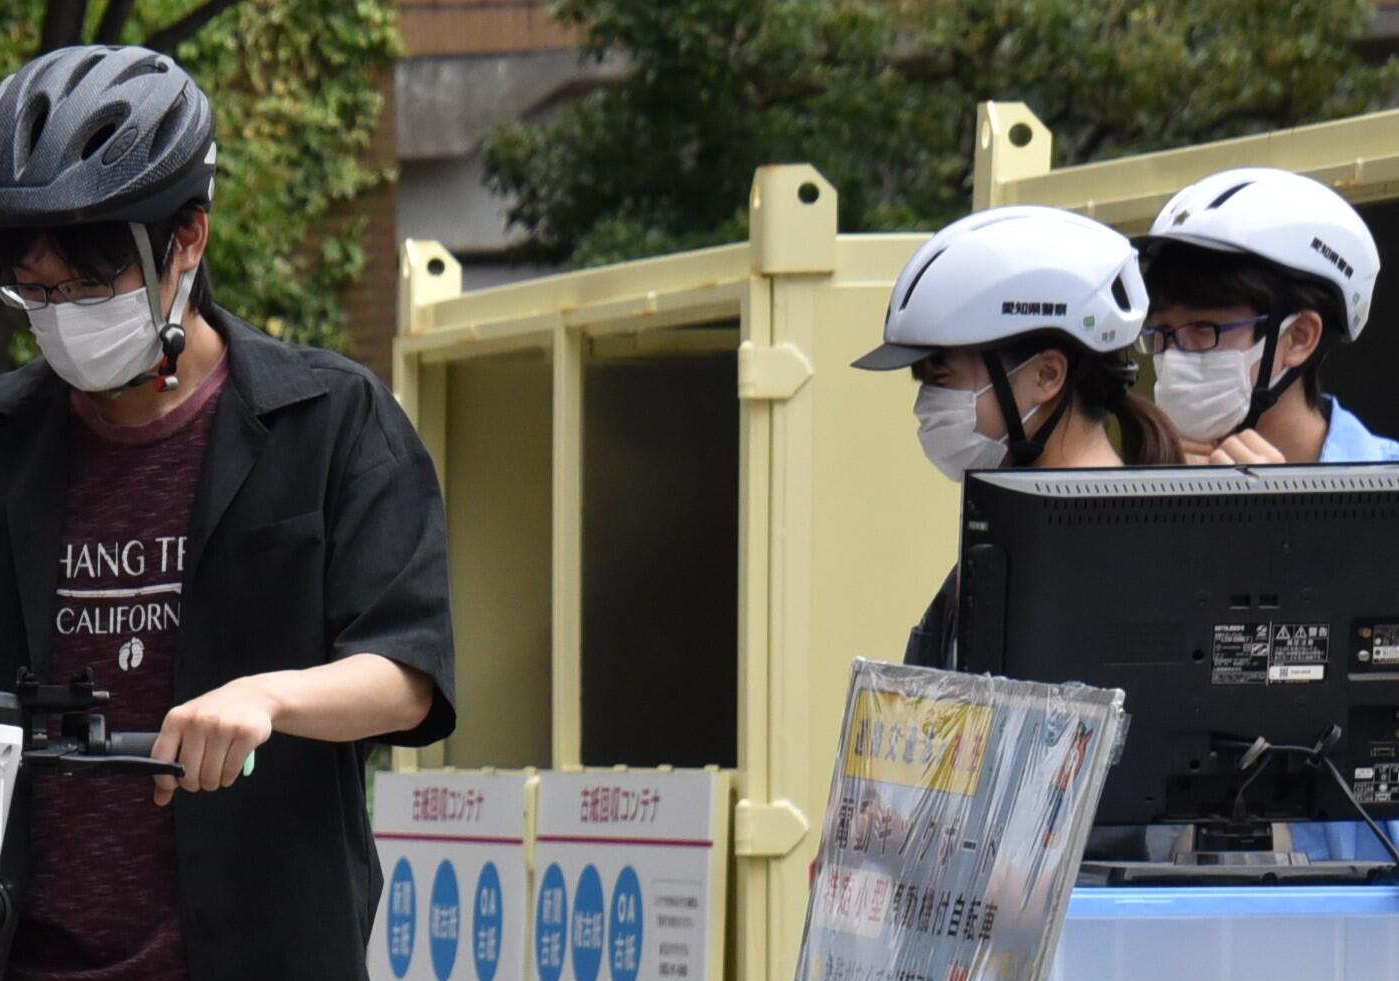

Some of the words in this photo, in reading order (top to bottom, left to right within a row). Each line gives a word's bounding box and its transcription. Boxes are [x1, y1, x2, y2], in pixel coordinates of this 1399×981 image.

[1002, 301, 1067, 316] 愛知県警察
[411, 787, 485, 823] 古紙回収コンテナ
[579, 787, 663, 824] 古紙回収コンテナ
